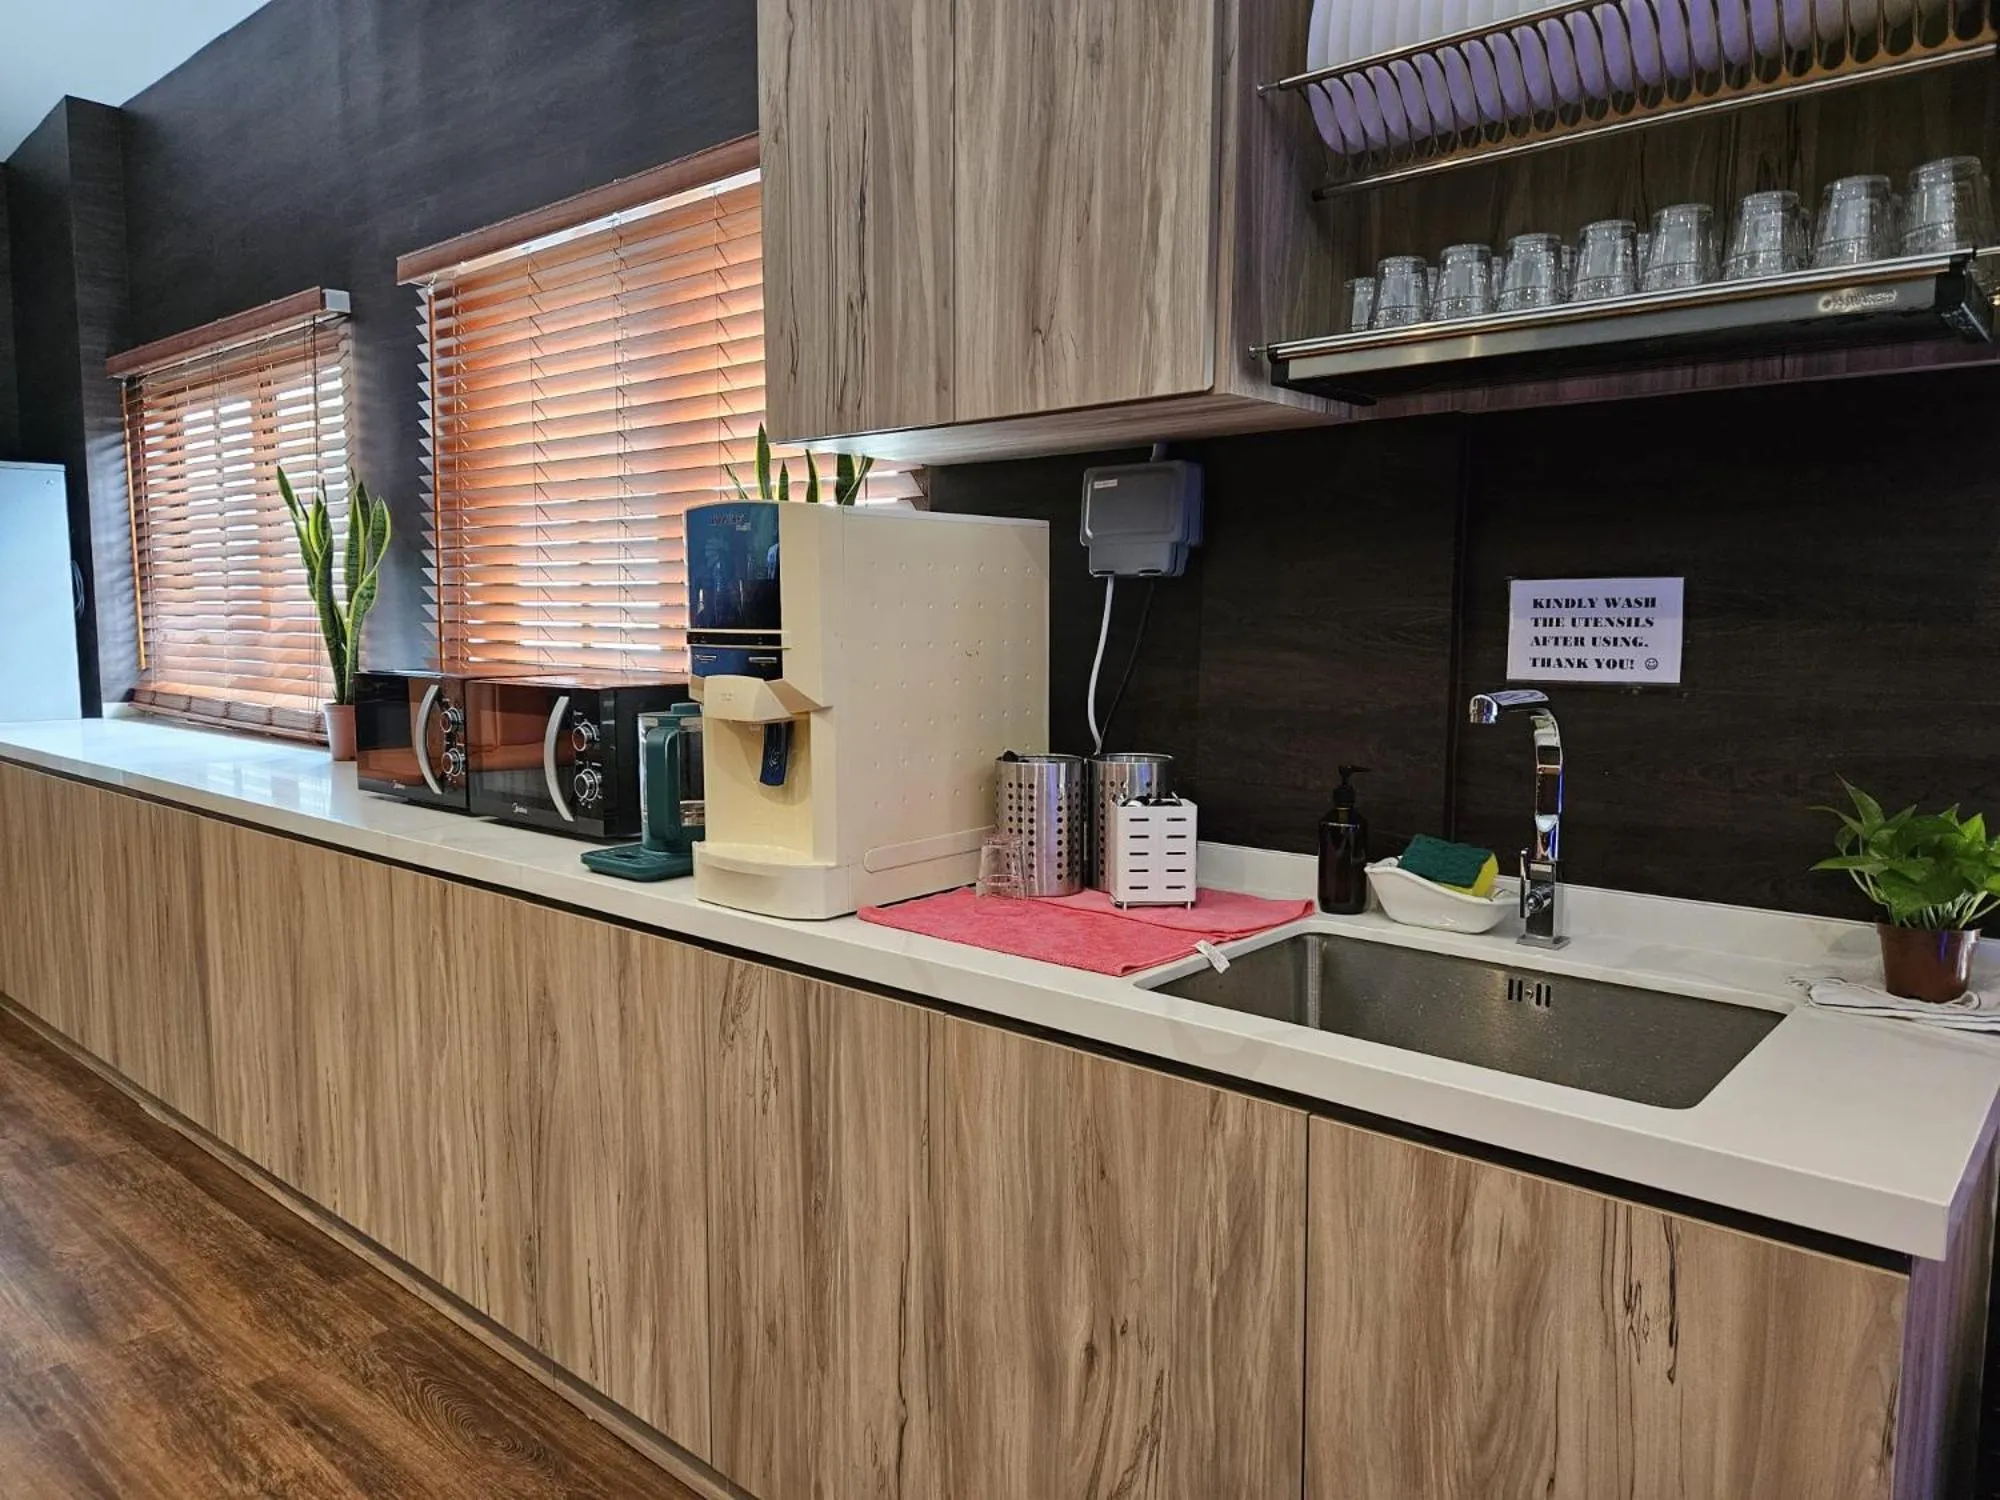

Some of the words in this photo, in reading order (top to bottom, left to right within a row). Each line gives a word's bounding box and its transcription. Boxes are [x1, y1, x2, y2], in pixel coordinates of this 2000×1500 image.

[1532, 598, 1599, 609] KINDLY
[1604, 597, 1657, 609] WASH
[1531, 617, 1565, 628] THE
[1571, 617, 1655, 628] UTENSILS
[1530, 636, 1585, 647] AFTER
[1591, 636, 1649, 648] USING.
[1529, 657, 1588, 669] THANK
[1595, 658, 1635, 670] YOU!
